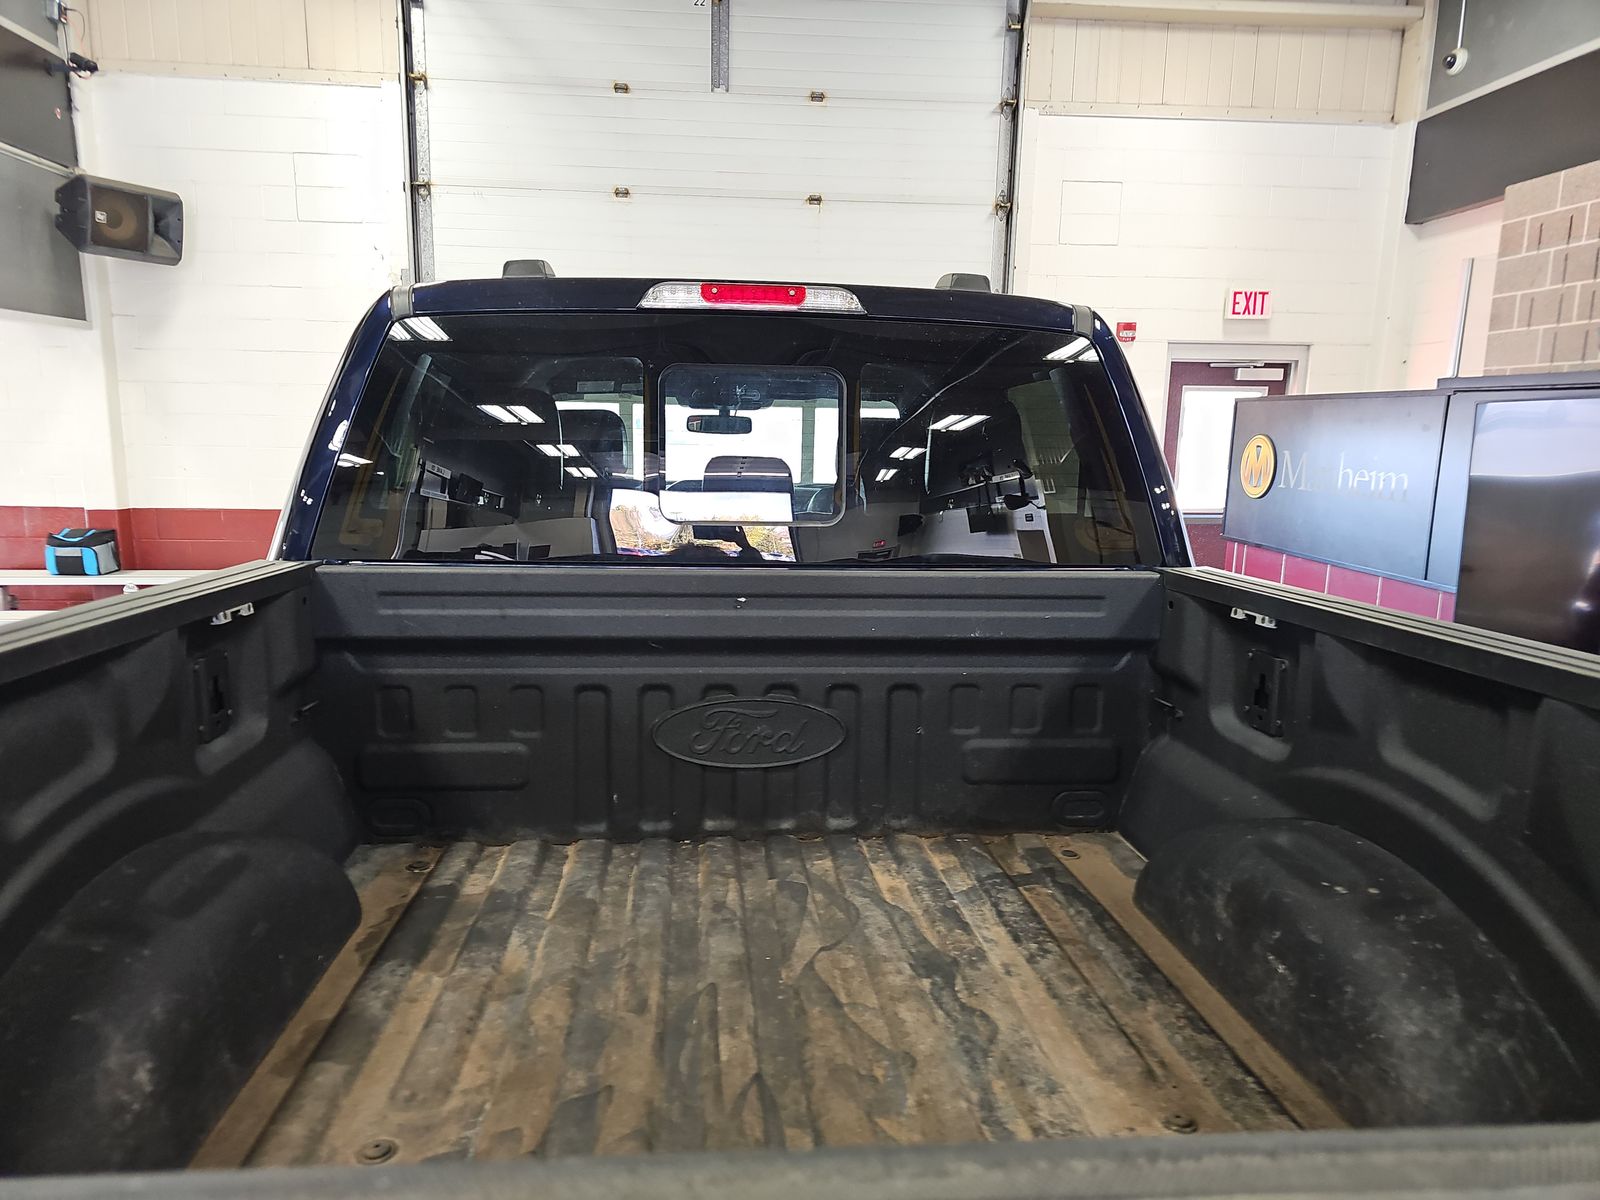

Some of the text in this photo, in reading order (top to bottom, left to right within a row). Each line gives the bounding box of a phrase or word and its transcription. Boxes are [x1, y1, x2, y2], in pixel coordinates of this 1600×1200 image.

[1231, 291, 1269, 315] EXIT
[1278, 450, 1409, 492] Mheim
[690, 708, 808, 754] Ford
